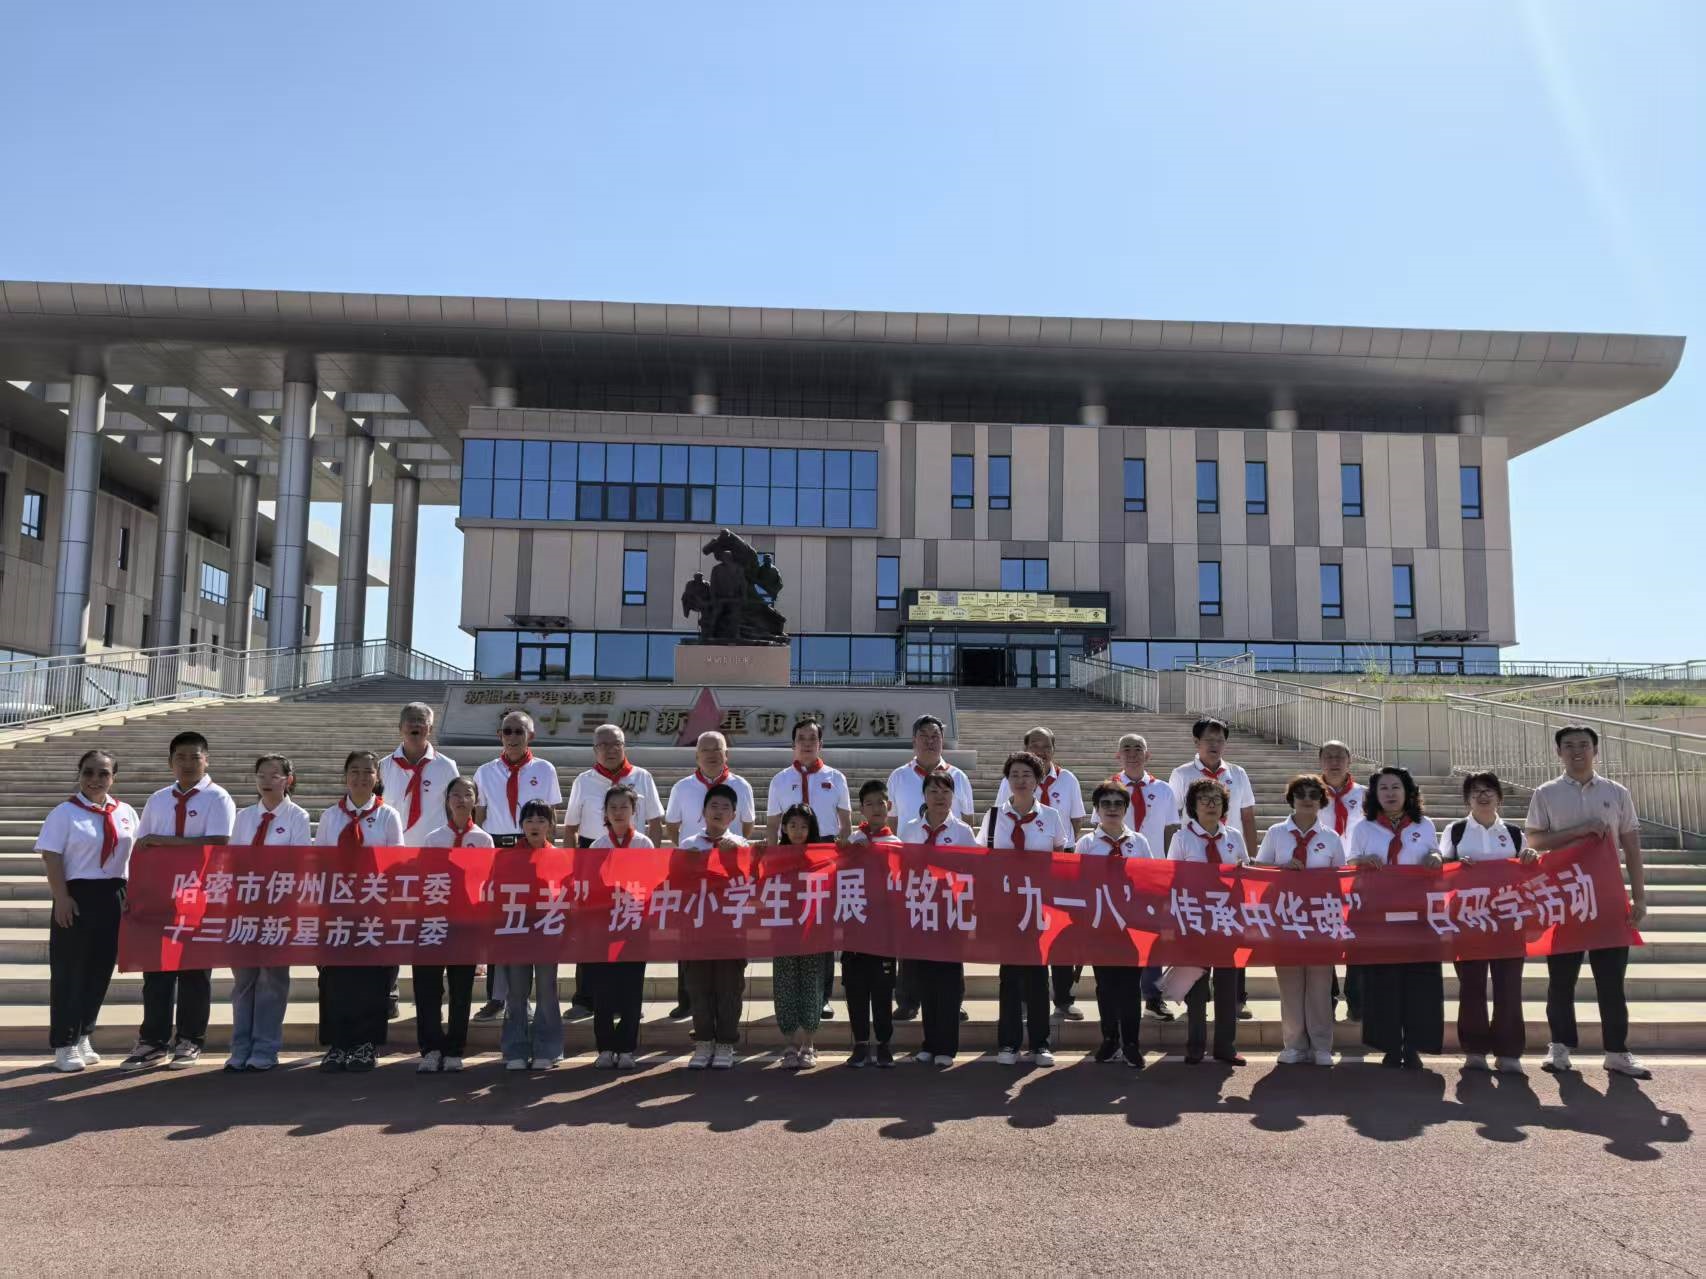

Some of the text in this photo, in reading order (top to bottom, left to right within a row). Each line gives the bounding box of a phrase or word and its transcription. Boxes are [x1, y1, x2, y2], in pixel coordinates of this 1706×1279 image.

[500, 706, 902, 737] 十三师新星市物馆
[171, 870, 452, 906] 哈密市伊州区关工委
[163, 915, 449, 947] 十三师新星市关工委
